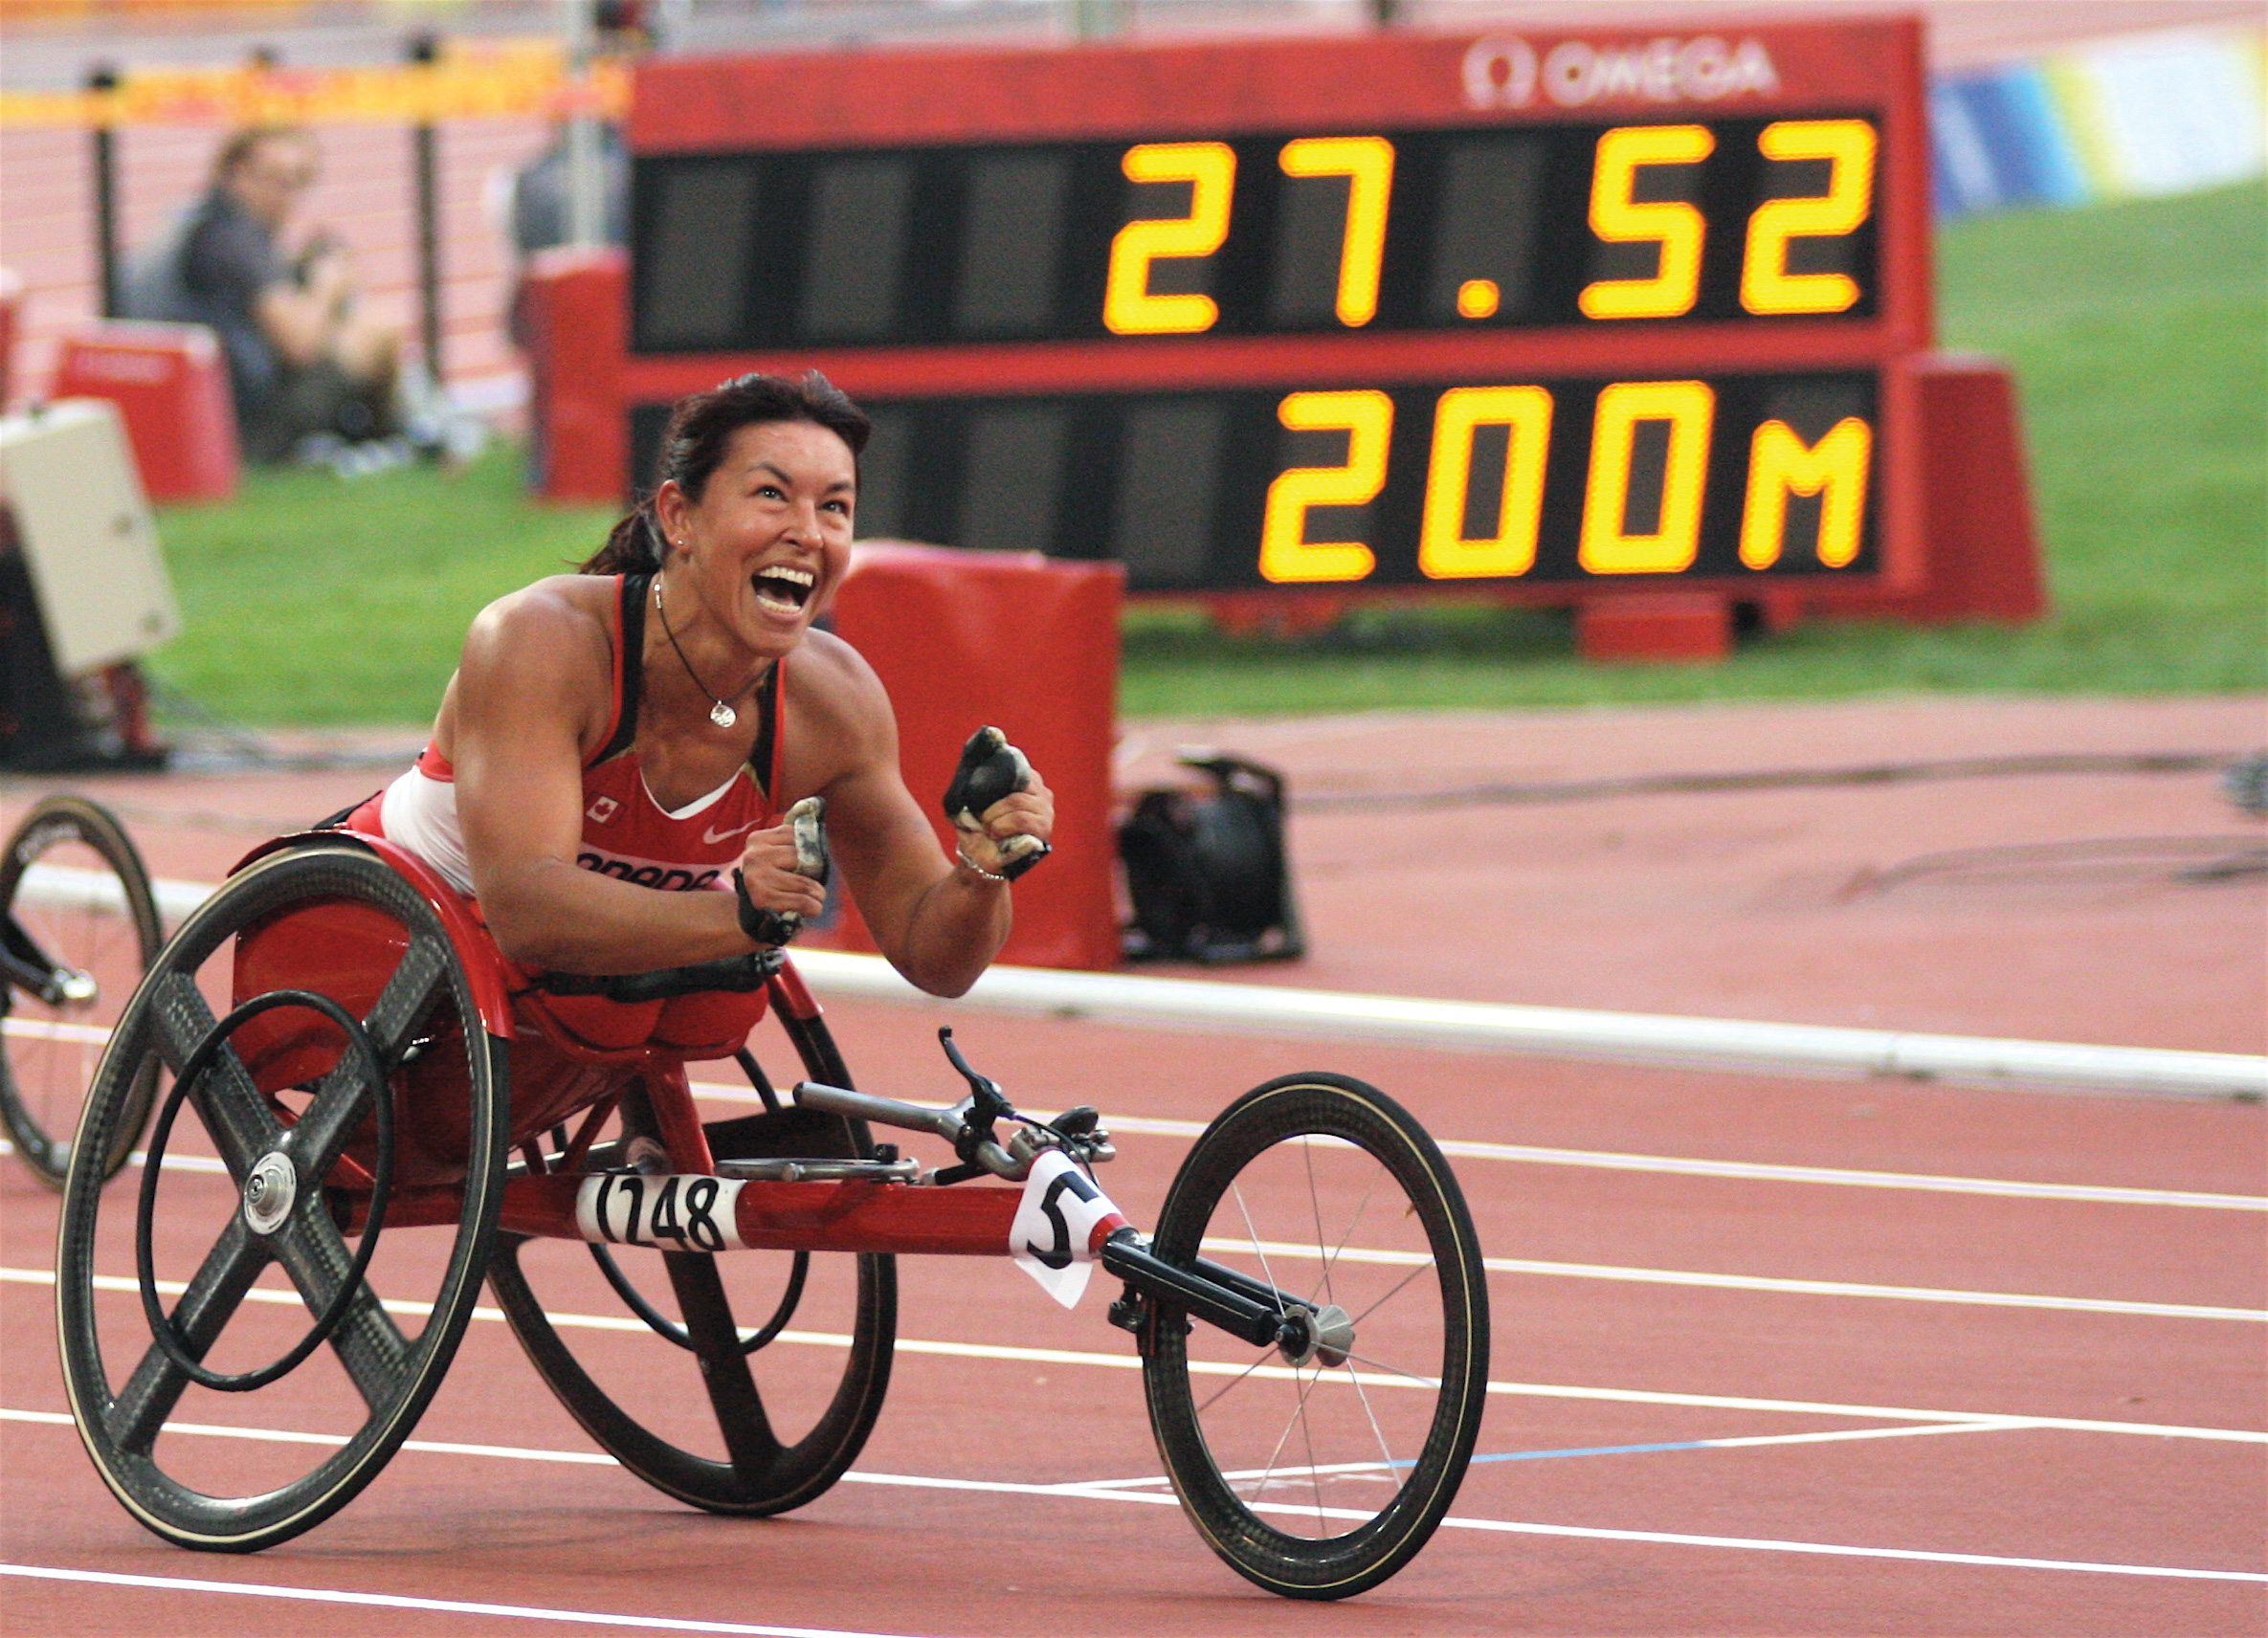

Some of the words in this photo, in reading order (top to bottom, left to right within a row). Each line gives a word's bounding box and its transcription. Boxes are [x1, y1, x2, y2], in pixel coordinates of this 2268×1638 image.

[1543, 37, 1778, 106] OMEGA
[1104, 120, 1877, 335] 27.52
[1027, 1170, 1100, 1270] 5
